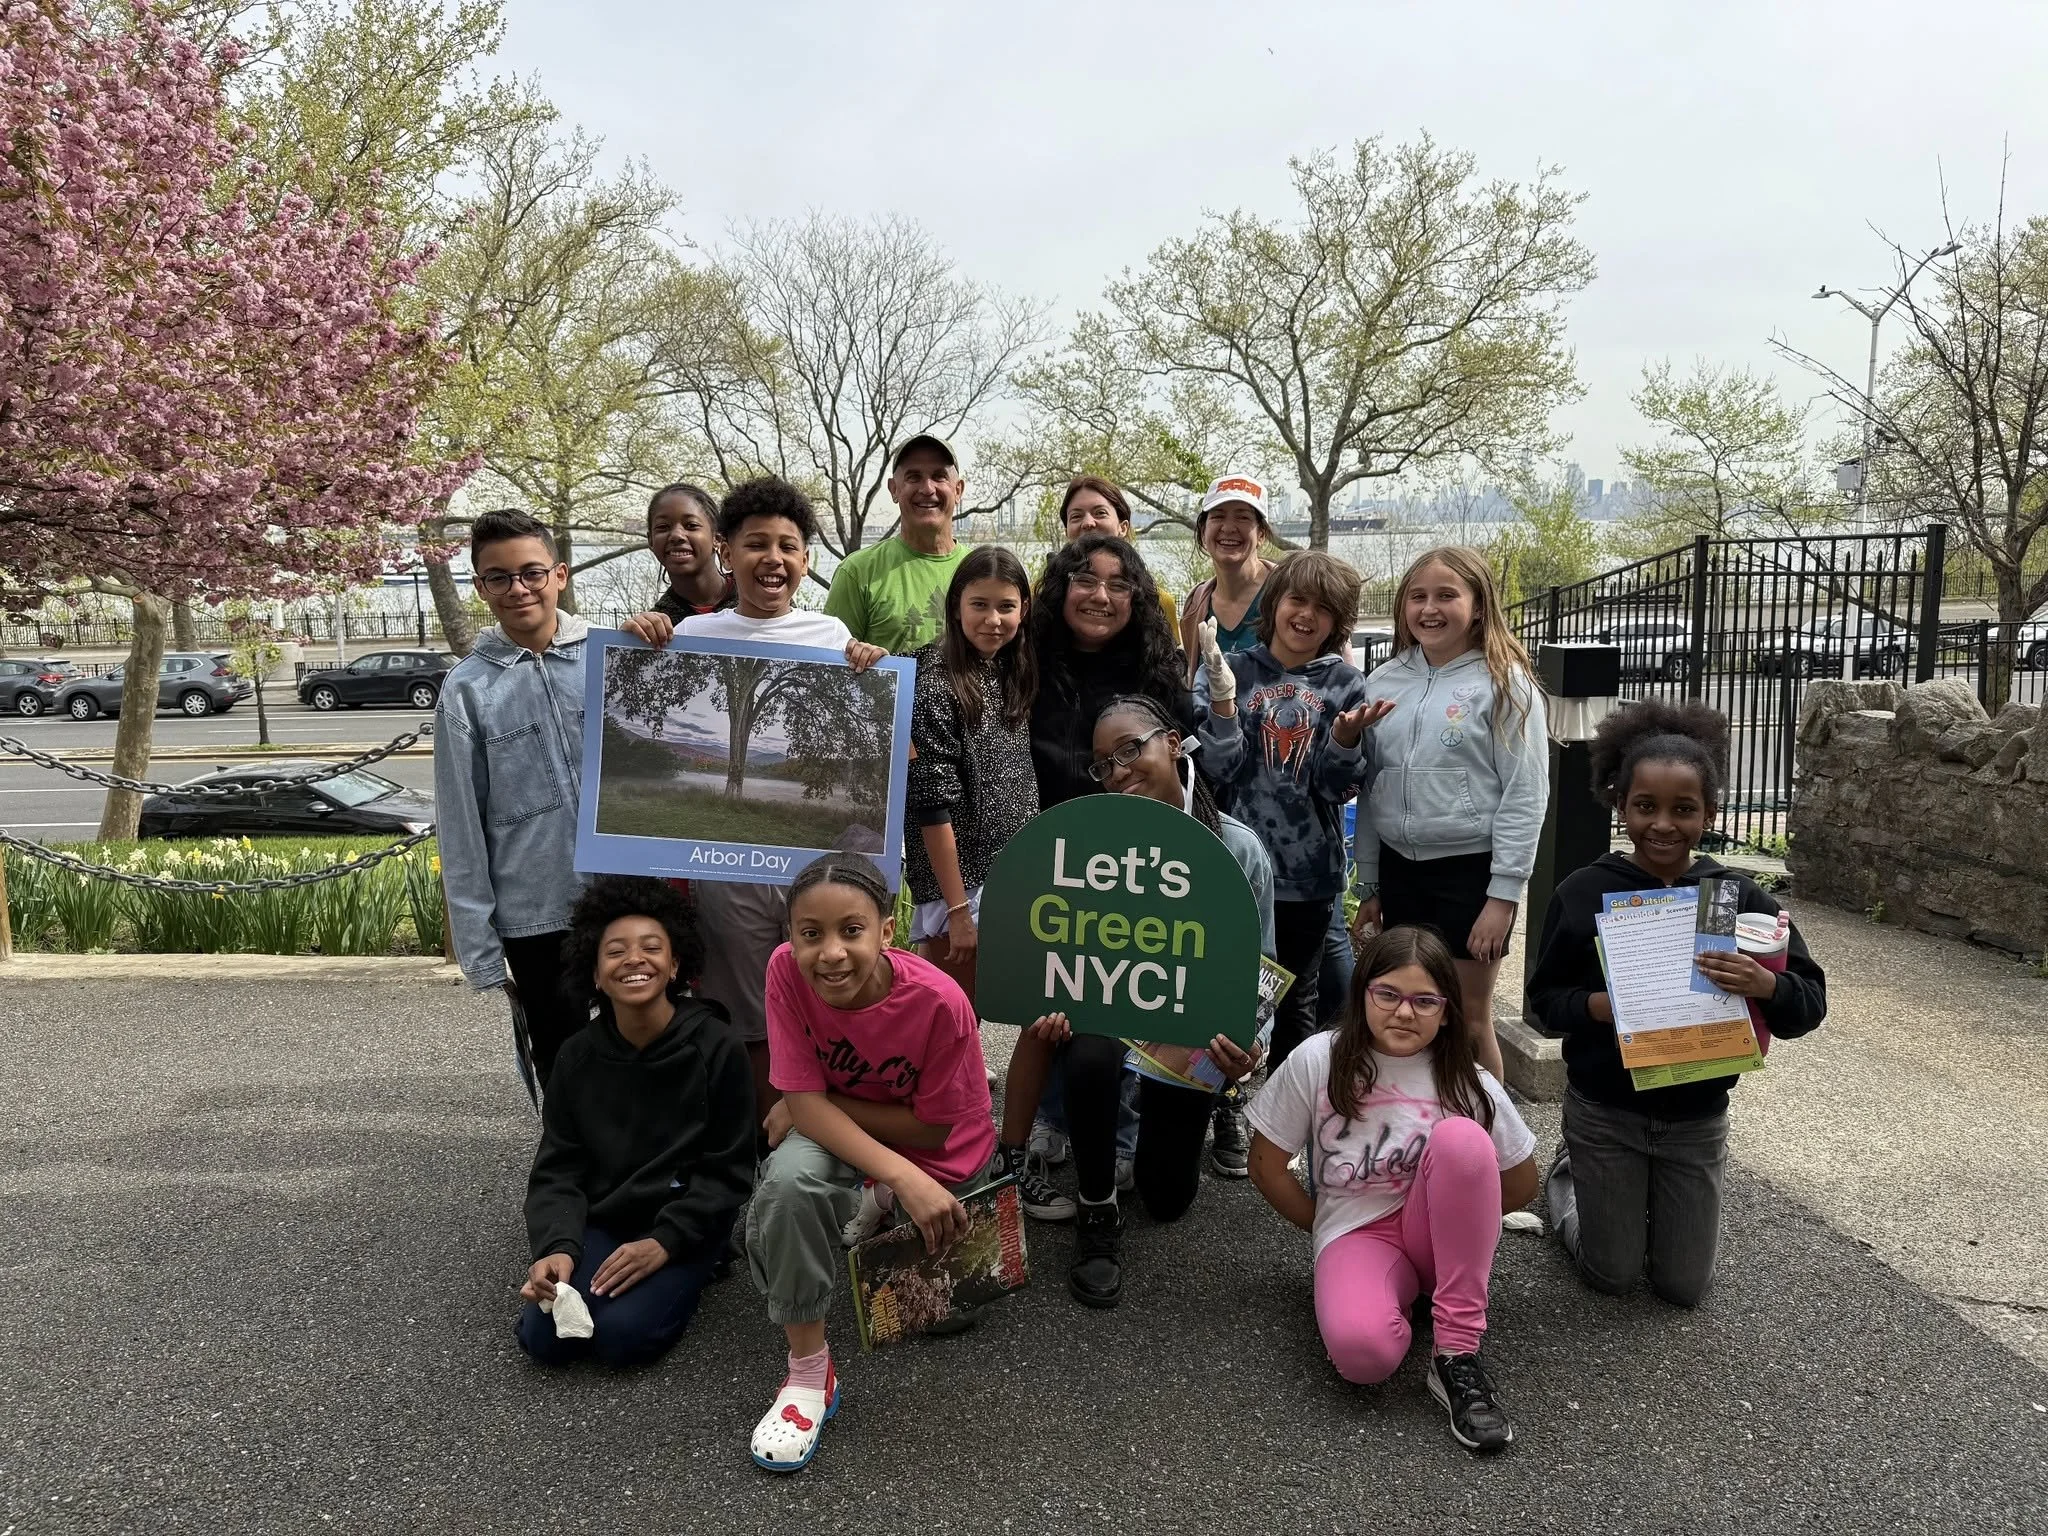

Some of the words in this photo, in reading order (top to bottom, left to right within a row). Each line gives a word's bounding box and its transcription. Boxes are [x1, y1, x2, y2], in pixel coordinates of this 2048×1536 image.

[689, 846, 746, 866] Arbor
[751, 850, 791, 873] Day
[1053, 838, 1191, 898] Let's
[1029, 894, 1206, 959] Green
[1044, 951, 1187, 1014] NYC!
